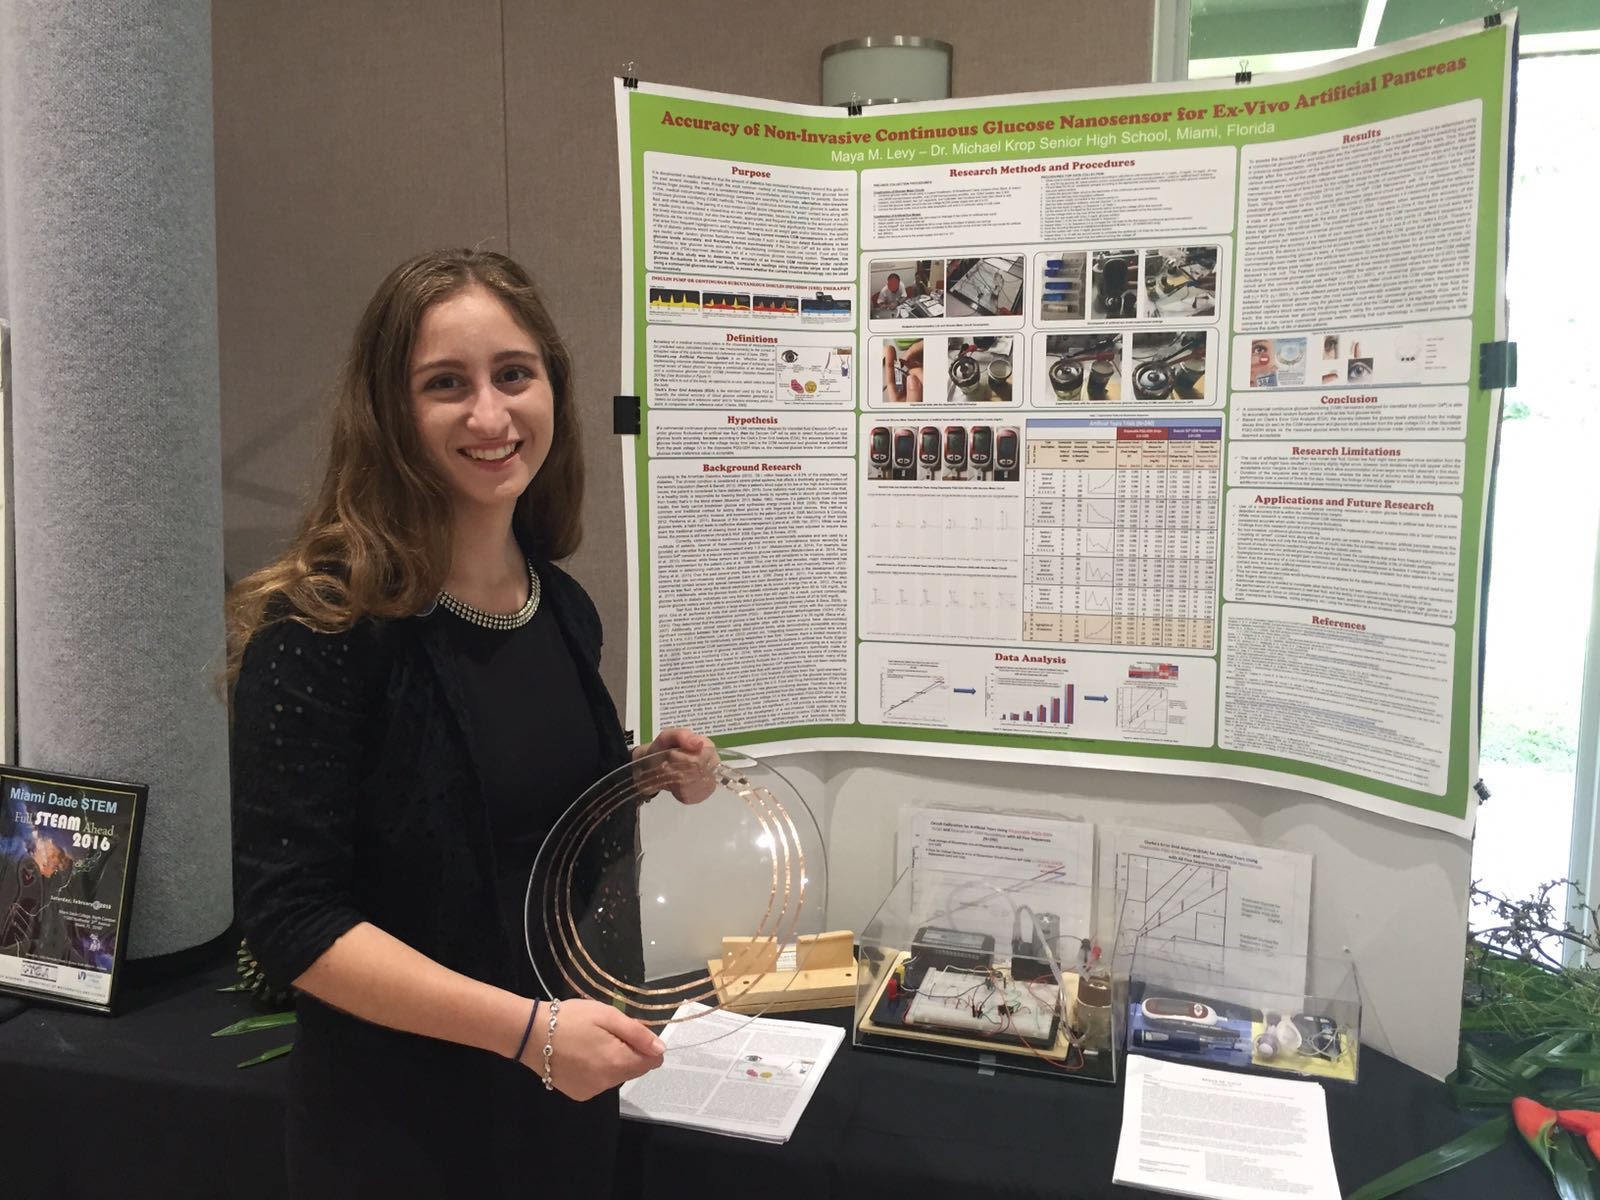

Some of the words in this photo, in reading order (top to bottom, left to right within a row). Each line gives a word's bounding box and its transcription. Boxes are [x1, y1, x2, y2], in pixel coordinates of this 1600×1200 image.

[661, 111, 739, 136] Accuracy
[744, 123, 760, 136] of
[764, 124, 871, 144] Non-Invasive
[875, 126, 978, 142] Continuous
[983, 119, 1055, 135] Glucose
[1059, 110, 1172, 130] Nanosensor
[1176, 107, 1208, 121] for
[1212, 100, 1290, 118] Ex-Vivo
[1294, 76, 1377, 110] Artificial
[1381, 57, 1467, 89] Pancreas
[831, 151, 864, 165] Maya
[868, 149, 882, 161] M.
[887, 147, 915, 161] Levy
[931, 145, 948, 157] Dr.
[952, 140, 1001, 155] Michael
[1005, 138, 1035, 153] Krop
[1039, 136, 1082, 149] Senior
[1086, 132, 1117, 148] High
[1121, 129, 1171, 144] School,
[1176, 126, 1221, 141] Miami,
[1227, 121, 1275, 137] Florida
[1342, 128, 1381, 145] Results
[731, 166, 771, 179] Purpose
[949, 167, 998, 178] Research
[1000, 164, 1046, 175] Methods
[1048, 162, 1069, 172] and
[1072, 158, 1135, 170] Procedures
[726, 333, 778, 344] Definitions
[1320, 394, 1378, 405] Conclusion
[727, 415, 778, 426] Hypothesis
[1292, 446, 1339, 456] Research
[1341, 447, 1401, 457] Limitations
[703, 463, 760, 473] Background
[762, 463, 801, 471] Research
[1254, 494, 1323, 507] Applications
[1325, 497, 1344, 507] and
[1347, 498, 1382, 509] Future
[1384, 499, 1434, 511] Research
[1311, 615, 1366, 631] References
[995, 652, 1020, 663] Data
[1023, 653, 1066, 665] Analysis
[10, 787, 46, 803] Miami
[48, 793, 78, 809] Dade
[81, 798, 118, 814] STEM
[15, 811, 33, 825] Full
[34, 811, 81, 831] STEAM
[83, 822, 115, 836] Ahead
[72, 832, 111, 851] 2016
